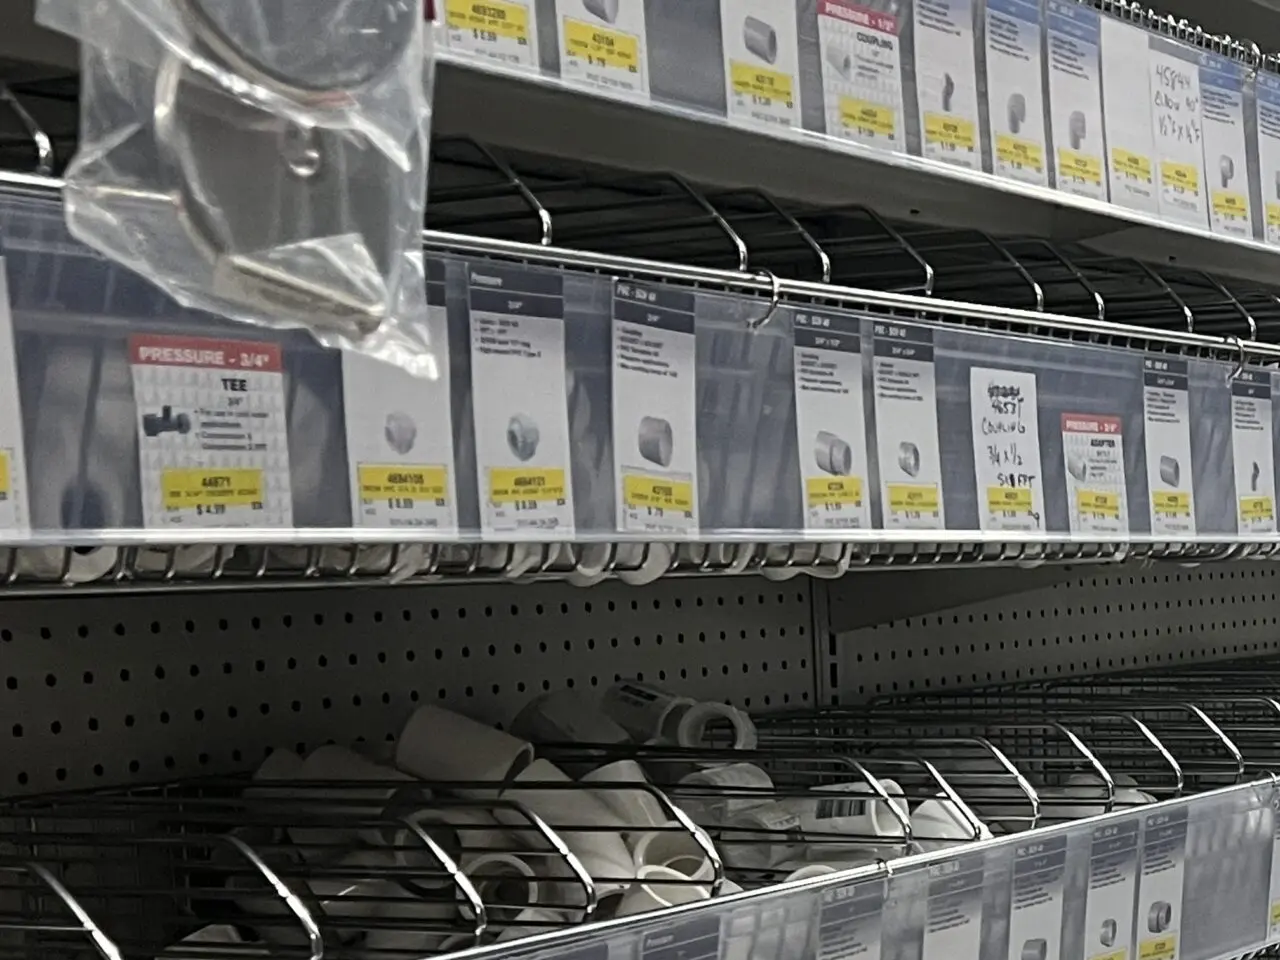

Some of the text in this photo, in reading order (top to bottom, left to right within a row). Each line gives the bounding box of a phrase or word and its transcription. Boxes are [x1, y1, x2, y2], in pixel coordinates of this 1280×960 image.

[139, 346, 225, 365] PRESSURE
[240, 353, 269, 367] 3/4"
[221, 378, 248, 392] TEE
